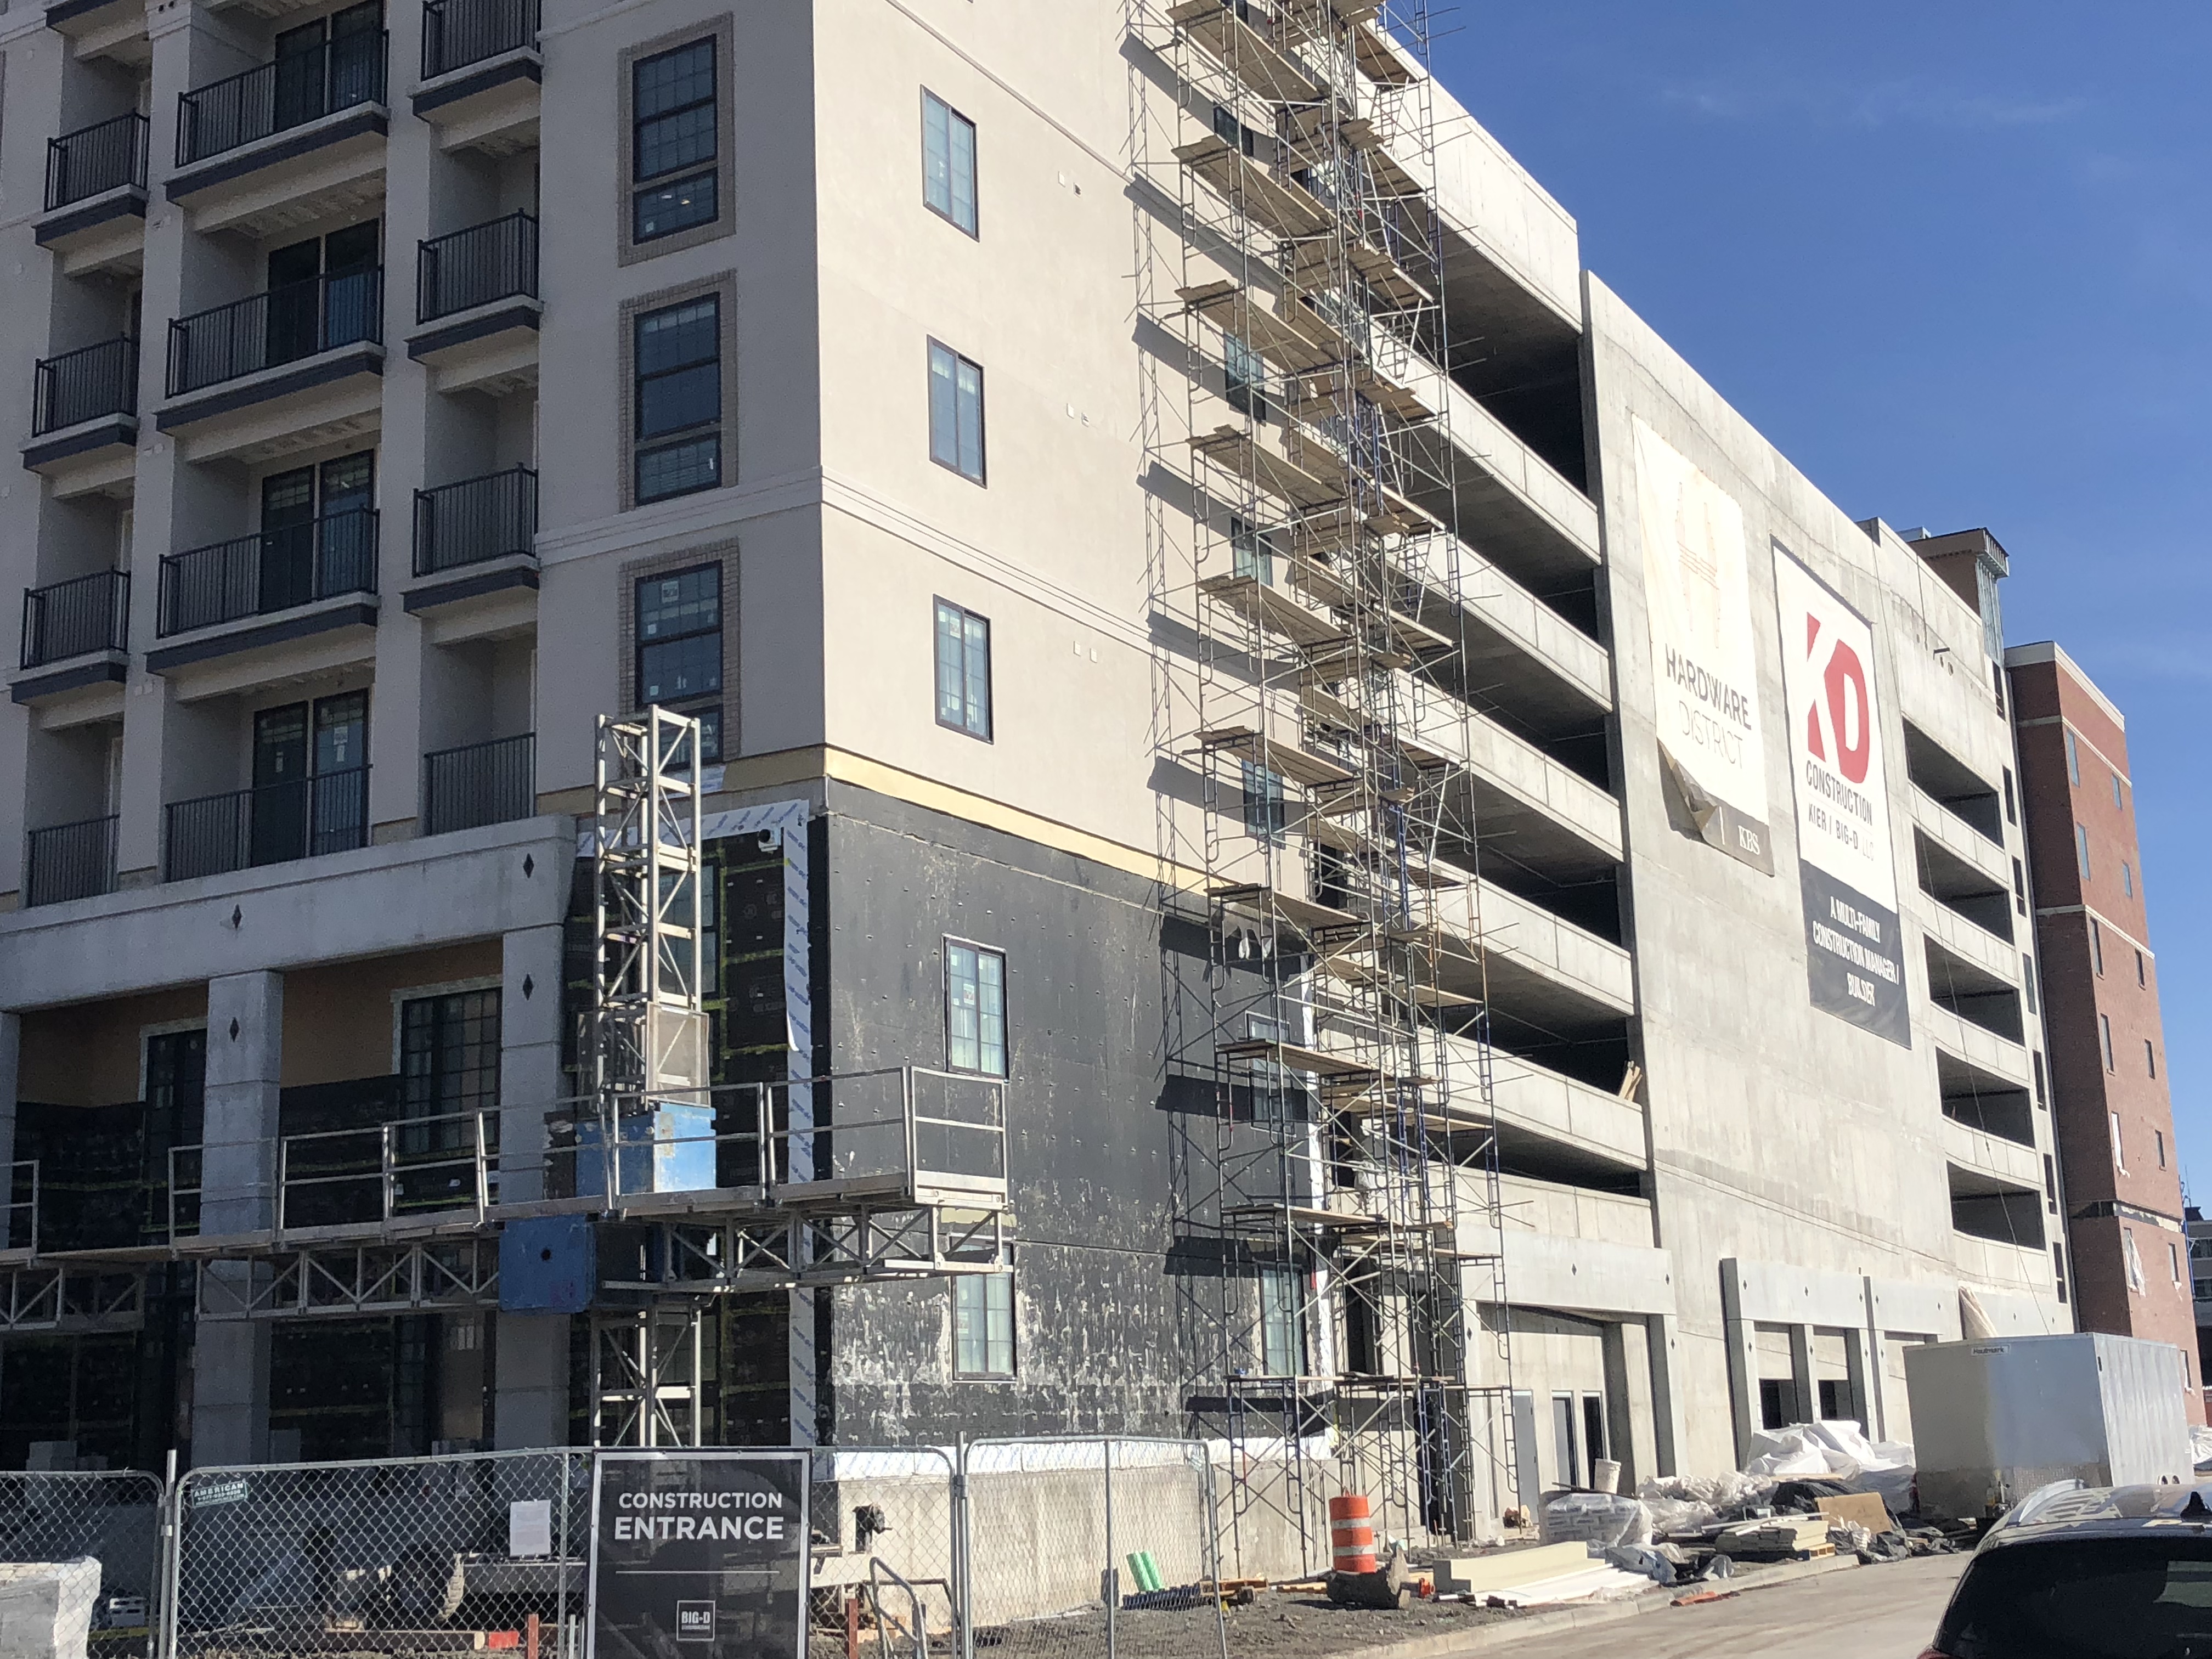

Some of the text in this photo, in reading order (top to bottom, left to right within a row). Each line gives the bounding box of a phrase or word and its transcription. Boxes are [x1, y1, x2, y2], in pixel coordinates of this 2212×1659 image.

[1666, 643, 1752, 730] HARDWARE
[1679, 701, 1743, 769] DISTRICT
[1807, 760, 1872, 826] CONSTRUCTION
[1809, 803, 1827, 831] KIER
[1738, 825, 1760, 855] KBS
[1830, 896, 1881, 944] A MULTI-FAMILY
[1813, 921, 1865, 968] CONSTRUCTION
[1864, 947, 1897, 984] MANAGER
[1847, 972, 1875, 1007] BUILDER
[194, 1483, 244, 1497] AMERICAN
[619, 1492, 782, 1509] CONSTRUCTION
[615, 1516, 784, 1540] ENTRANCE
[681, 1611, 710, 1624] BIG-D
